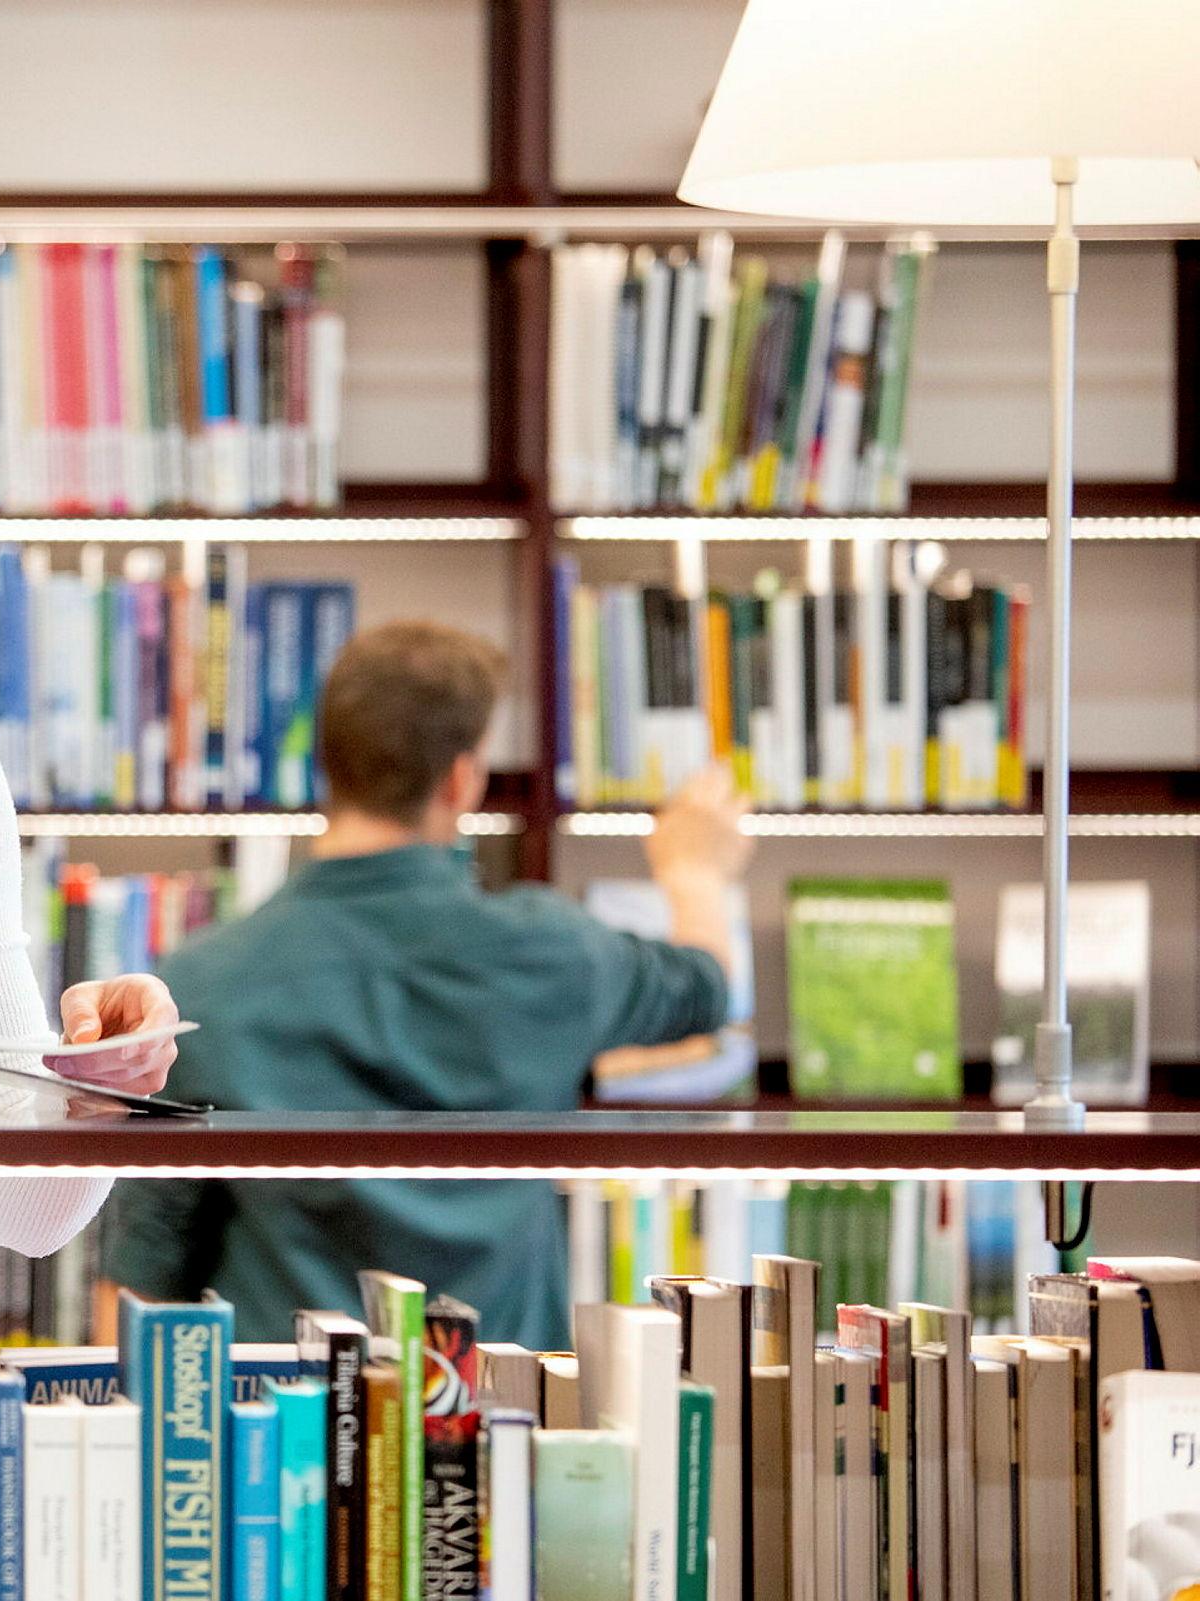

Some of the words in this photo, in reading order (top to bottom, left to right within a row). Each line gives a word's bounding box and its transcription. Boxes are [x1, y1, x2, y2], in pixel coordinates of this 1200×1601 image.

[165, 1323, 211, 1442] Stoskopf
[335, 1414, 359, 1487] Culture
[164, 1457, 211, 1548] FISH
